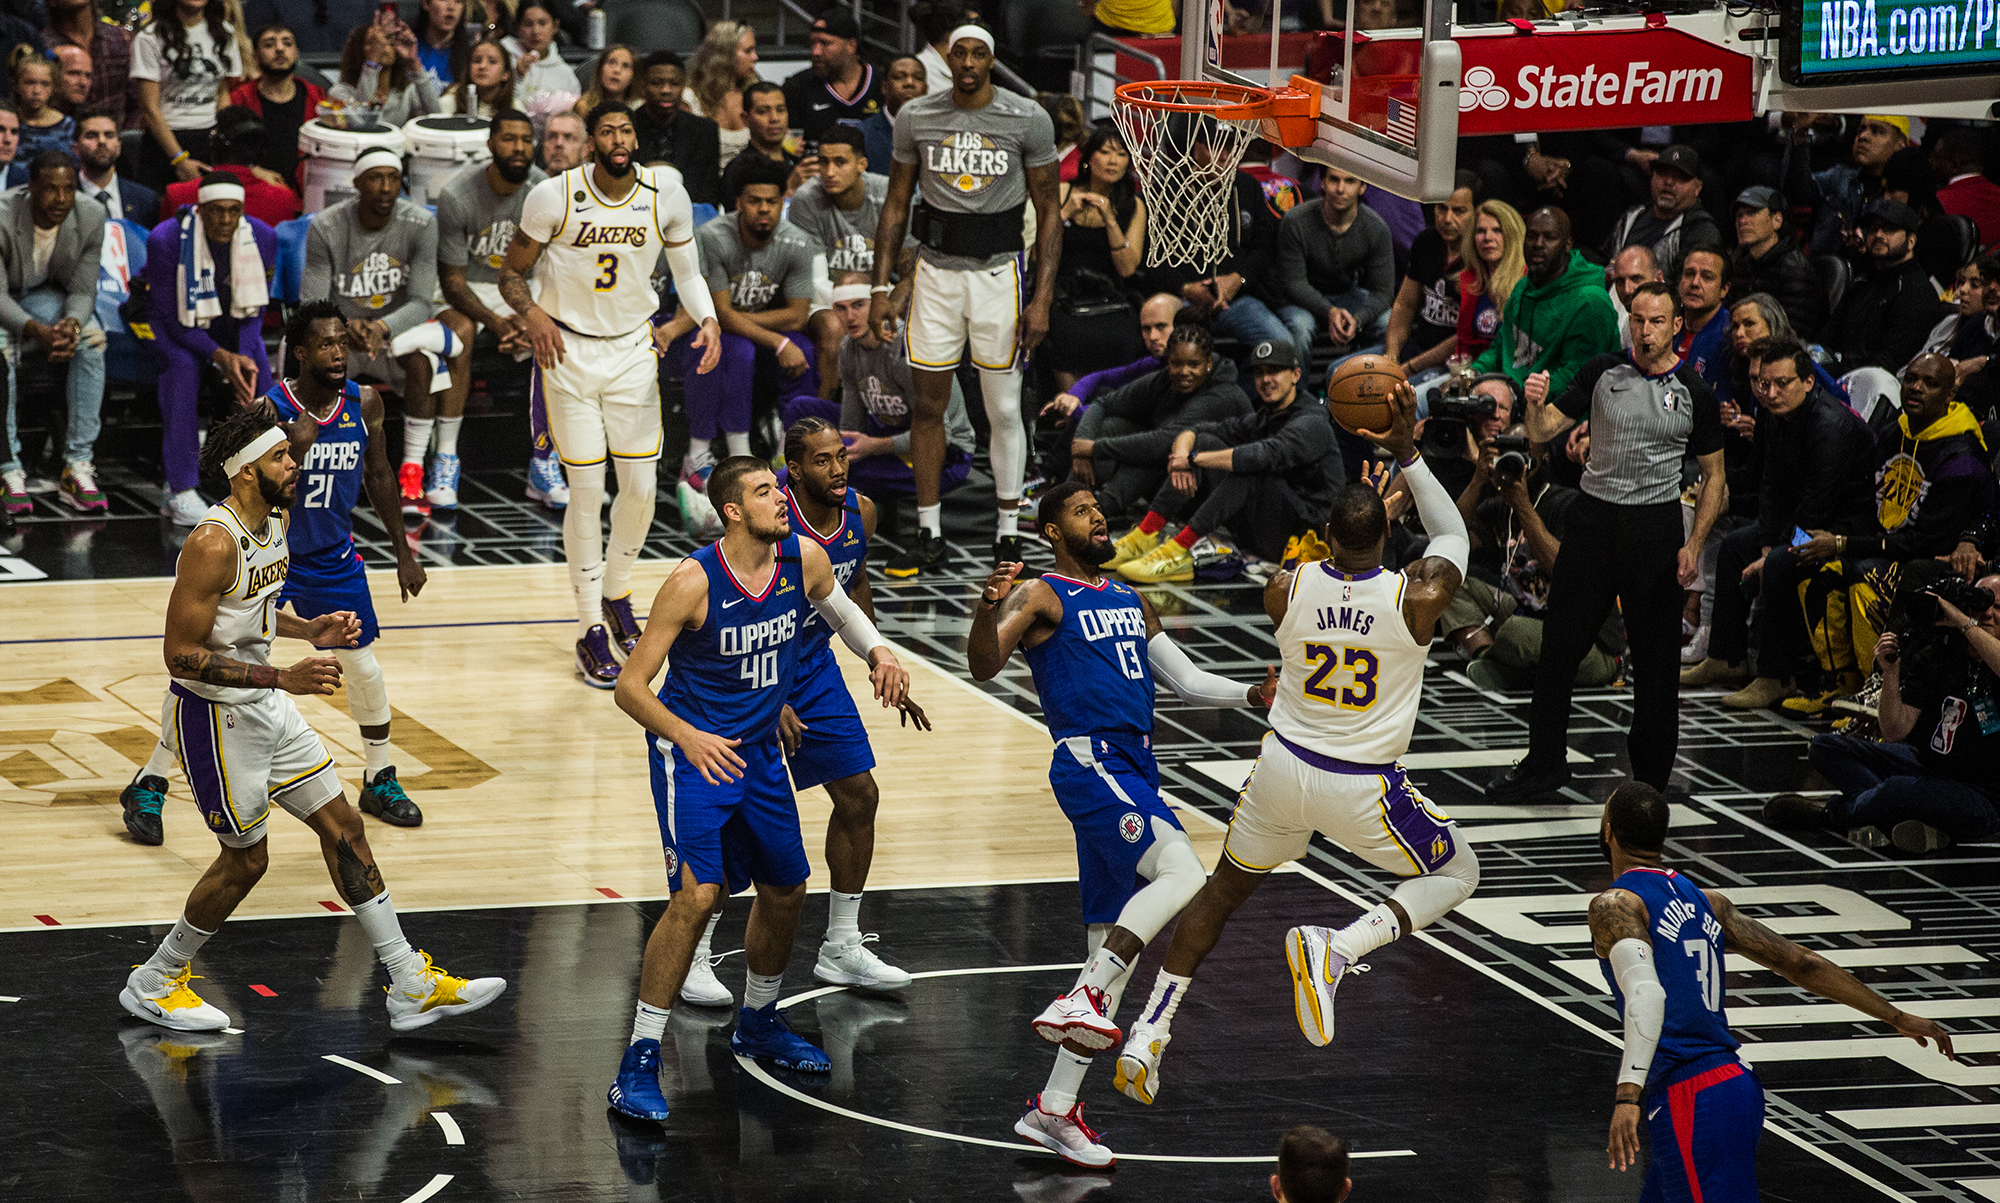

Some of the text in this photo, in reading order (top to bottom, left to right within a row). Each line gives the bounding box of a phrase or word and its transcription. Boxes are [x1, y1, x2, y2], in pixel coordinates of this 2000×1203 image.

[1820, 0, 2000, 60] NBA.com/P
[954, 132, 983, 151] LOS
[926, 146, 1009, 175] LAKERS
[571, 221, 647, 248] LAKERS
[363, 252, 391, 272] LOS
[593, 252, 620, 293] 3
[302, 441, 360, 471] IPPERS
[304, 474, 334, 509] 21
[241, 556, 288, 602] LAKERS
[775, 584, 796, 597] bumble
[719, 608, 797, 657] CLIPPERS
[1078, 607, 1147, 642] CLIPPERS
[1317, 606, 1375, 636] JAMES
[740, 650, 779, 690] 40
[1114, 641, 1144, 680] 13
[1303, 641, 1380, 713] 23
[1683, 939, 1721, 1013] 31
